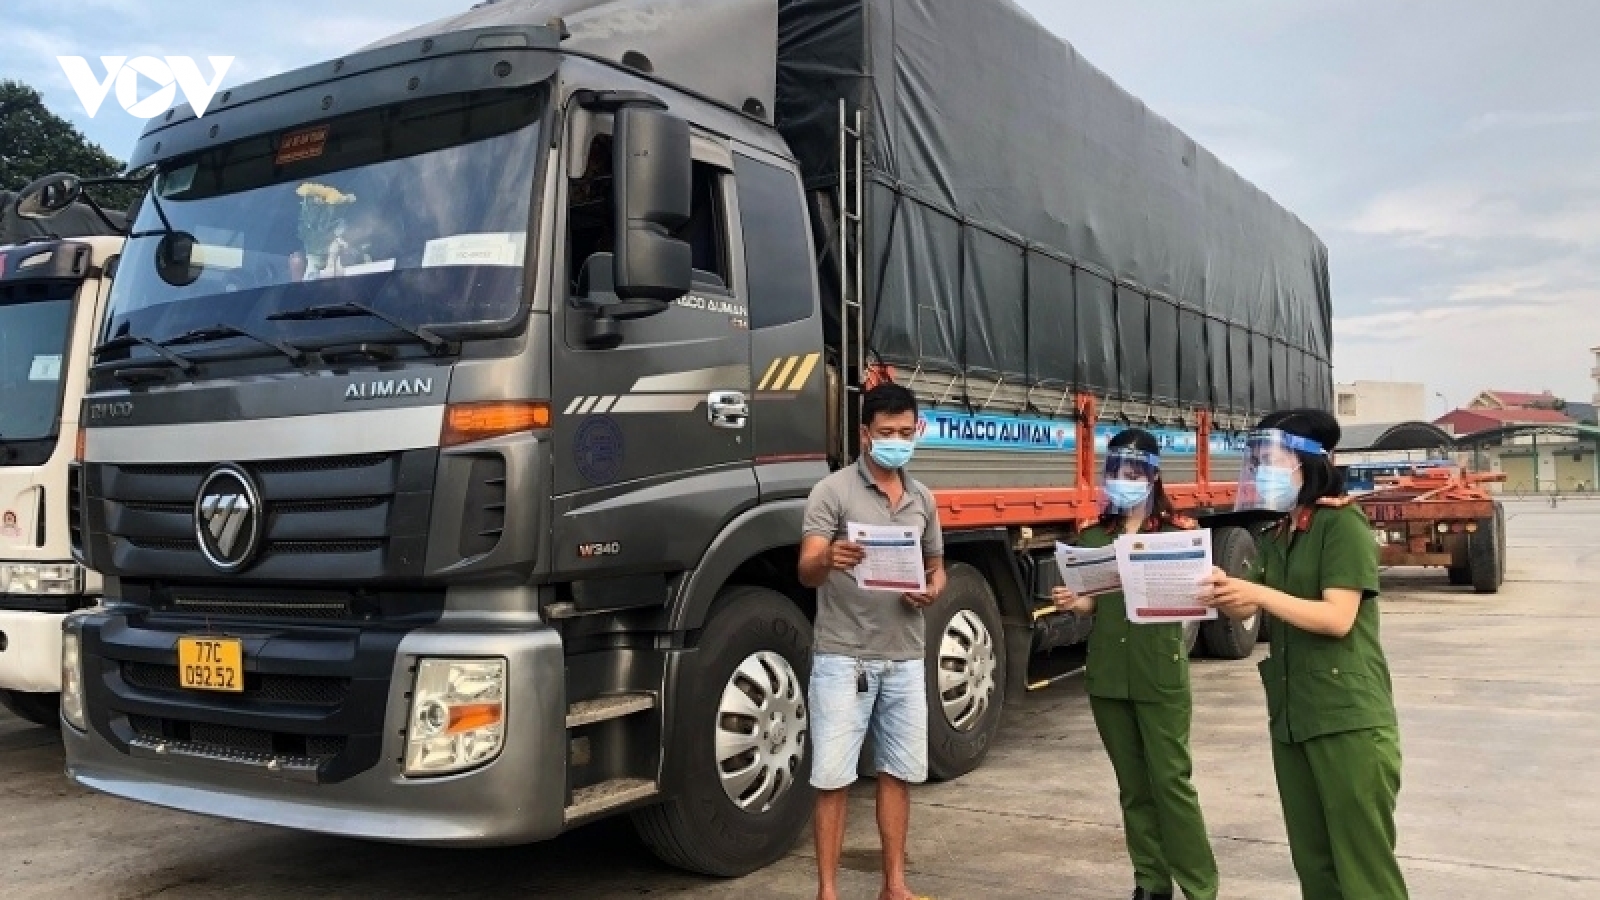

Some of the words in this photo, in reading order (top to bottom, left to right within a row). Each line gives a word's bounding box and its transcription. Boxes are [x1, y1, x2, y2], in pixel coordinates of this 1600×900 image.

[344, 377, 433, 397] AUMAN
[935, 417, 997, 441] THACO
[999, 421, 1051, 444] AUMAN
[195, 641, 222, 663] 77C
[185, 665, 235, 689] 092.52
